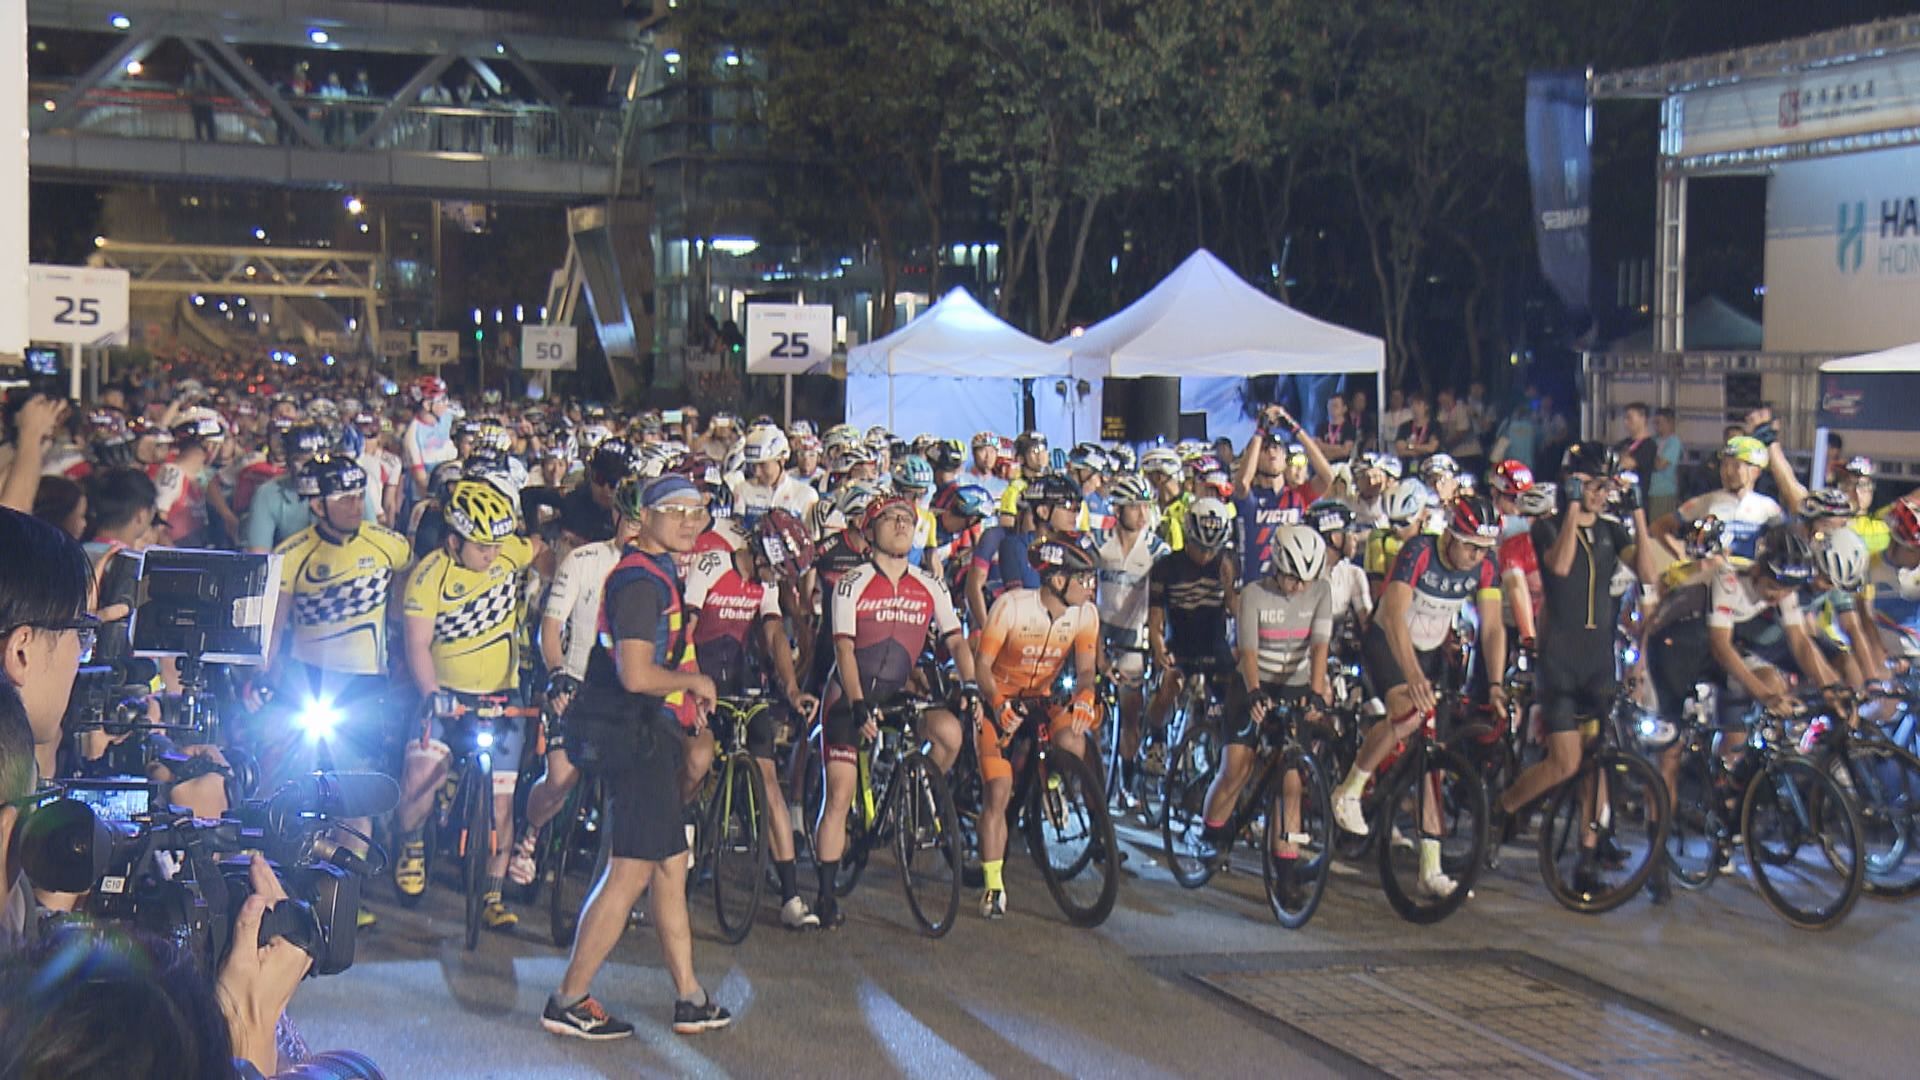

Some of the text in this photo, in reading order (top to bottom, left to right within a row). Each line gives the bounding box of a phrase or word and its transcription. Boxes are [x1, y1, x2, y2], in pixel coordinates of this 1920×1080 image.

[54, 296, 99, 325] 25
[430, 344, 448, 357] 75
[537, 343, 562, 359] 50
[770, 332, 810, 358] 25
